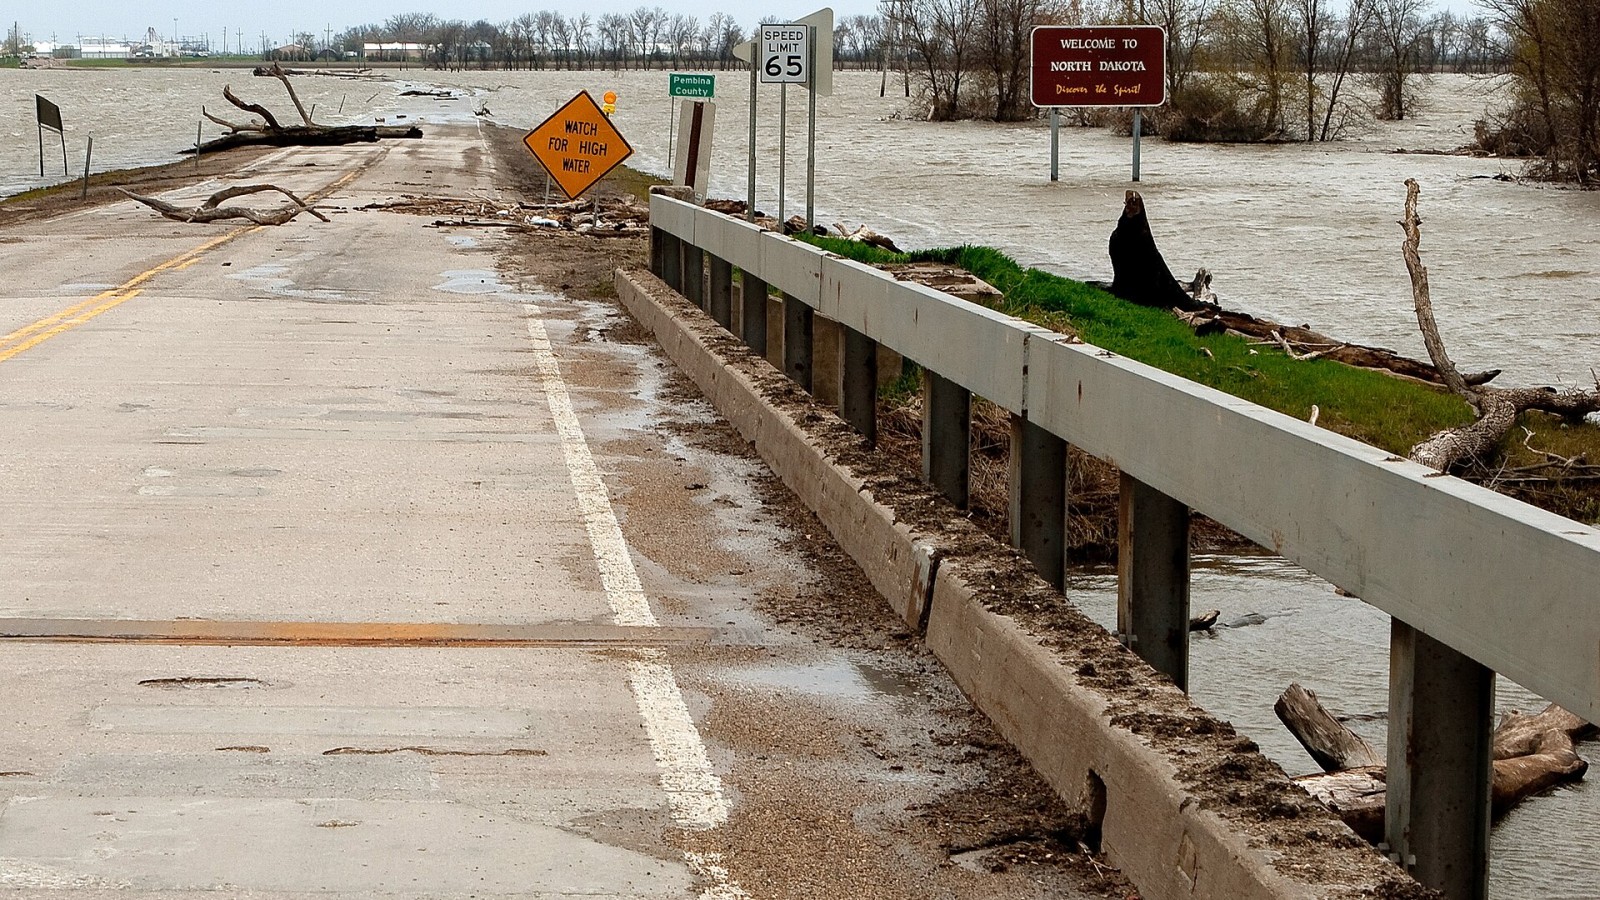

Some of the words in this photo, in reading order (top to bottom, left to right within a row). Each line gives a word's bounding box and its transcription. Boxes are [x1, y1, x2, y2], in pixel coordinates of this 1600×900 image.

[764, 31, 804, 40] SPEED
[768, 43, 799, 53] LIMIT
[1060, 39, 1116, 49] WELCOME
[1122, 39, 1138, 49] TO
[765, 55, 803, 77] 65
[1050, 61, 1092, 71] NORTH
[1099, 61, 1146, 71] DAKOTA
[673, 76, 711, 85] Pembina
[675, 87, 708, 97] County
[1056, 84, 1088, 95] Discover
[1095, 83, 1107, 93] the
[1114, 83, 1141, 97] Spirit!
[564, 120, 598, 136] WATCH
[548, 137, 568, 152] FOR
[579, 140, 608, 156] HIGH
[562, 157, 591, 174] WATER
